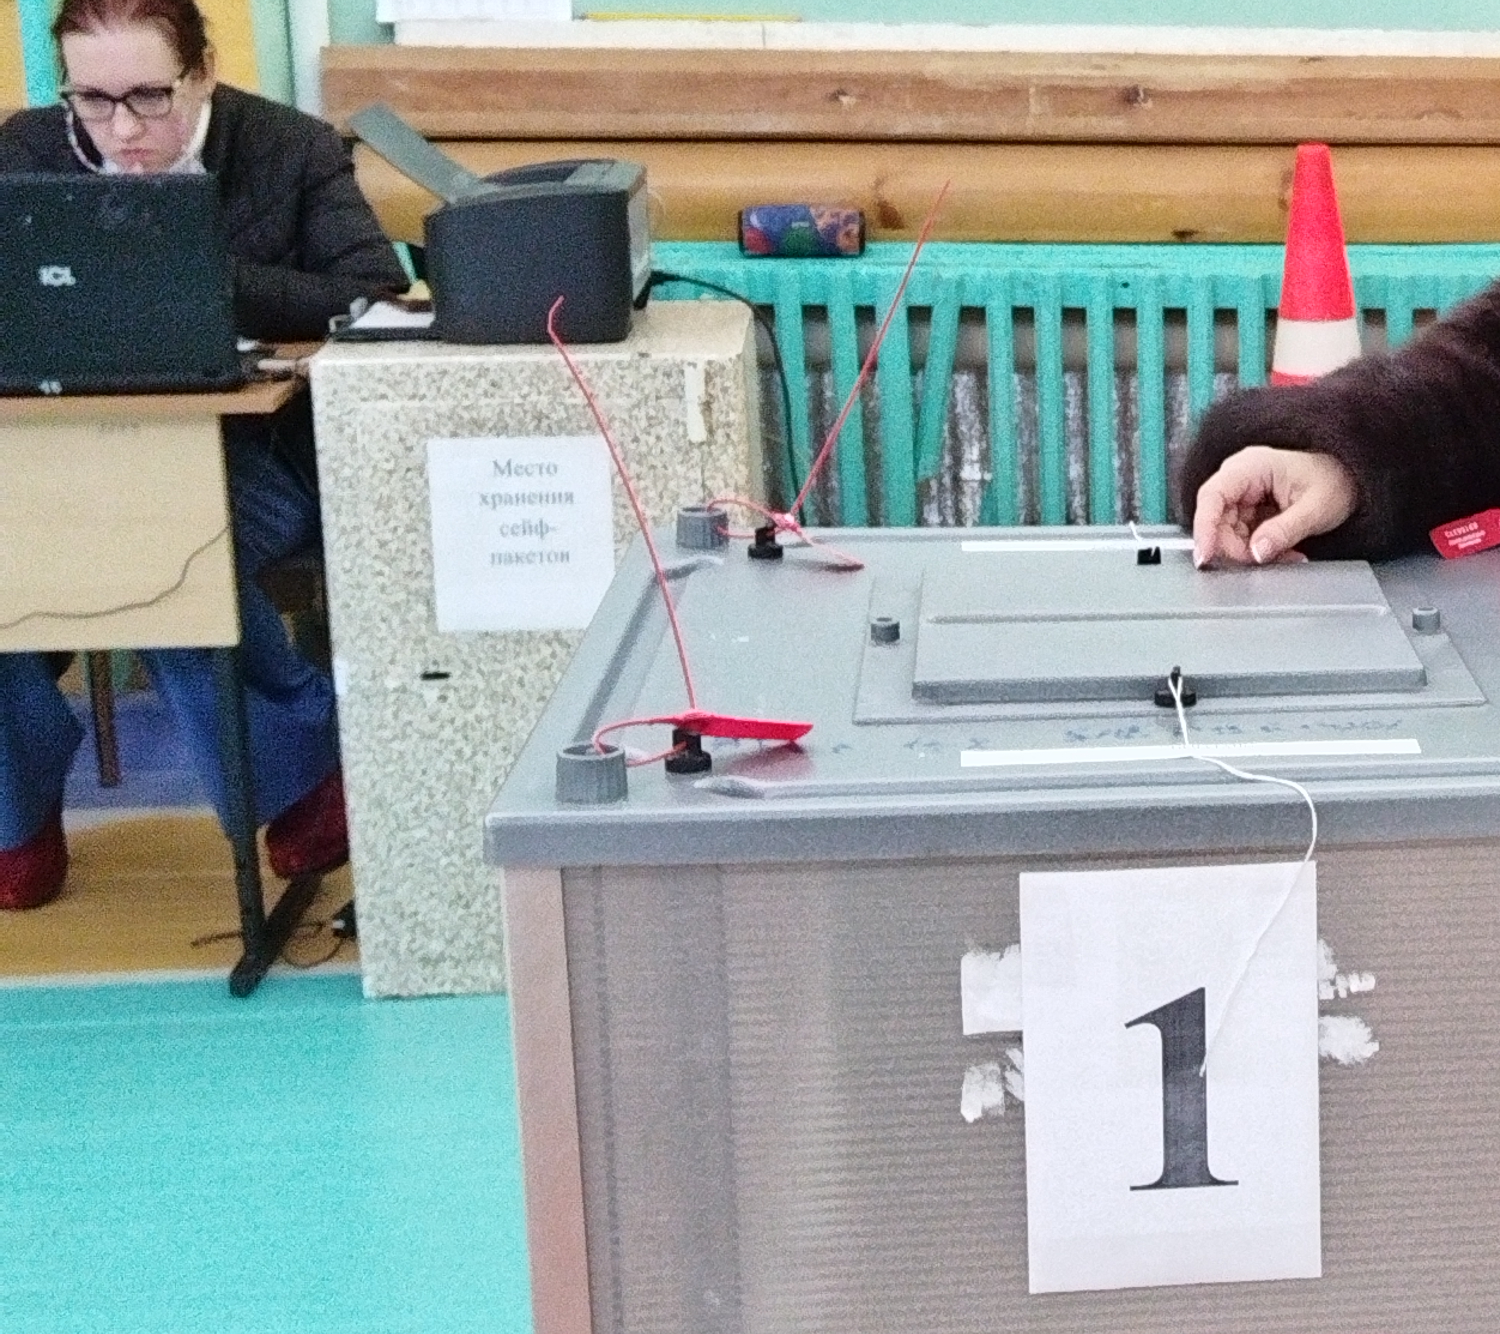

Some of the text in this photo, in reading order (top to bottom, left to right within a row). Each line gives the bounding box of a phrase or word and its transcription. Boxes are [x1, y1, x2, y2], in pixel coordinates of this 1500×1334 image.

[492, 458, 558, 478] Место
[478, 490, 575, 510] хранения
[499, 518, 557, 539] сейф-
[1124, 986, 1239, 1192] 1
